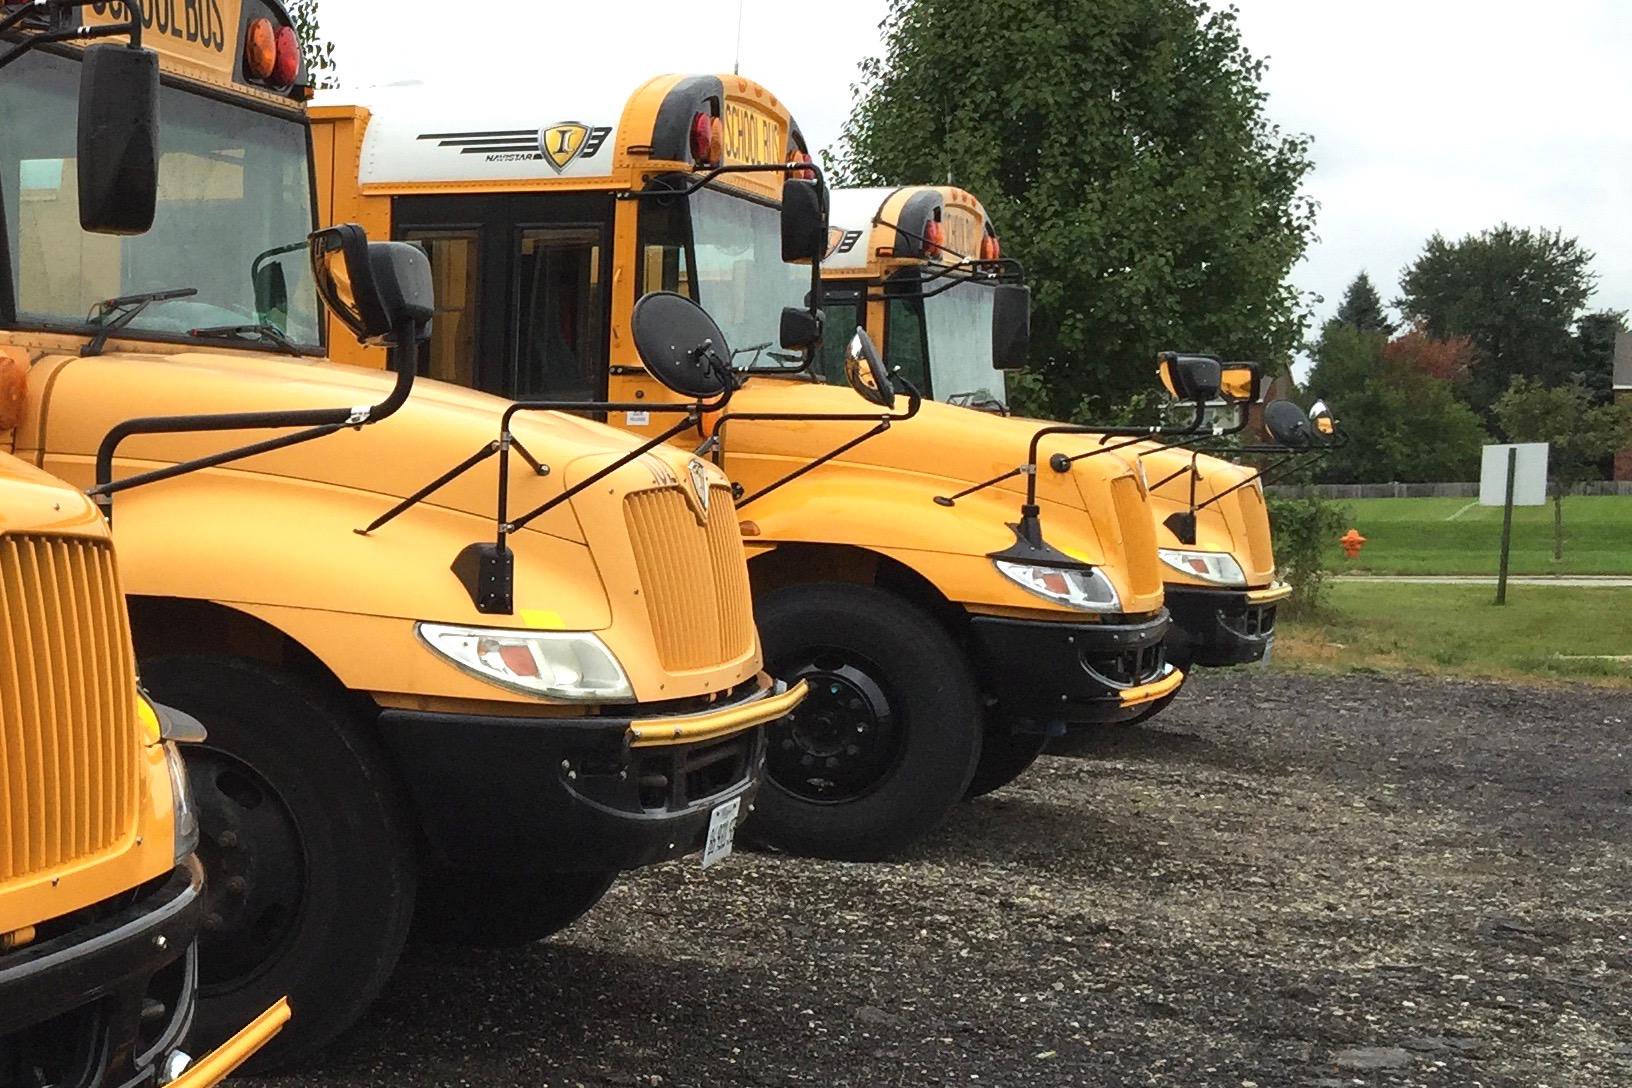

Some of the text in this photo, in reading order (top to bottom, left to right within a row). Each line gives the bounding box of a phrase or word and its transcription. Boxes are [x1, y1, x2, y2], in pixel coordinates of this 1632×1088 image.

[185, 0, 225, 52] BUS
[485, 153, 534, 162] NAVISTAR
[725, 103, 761, 166] SCHOOL
